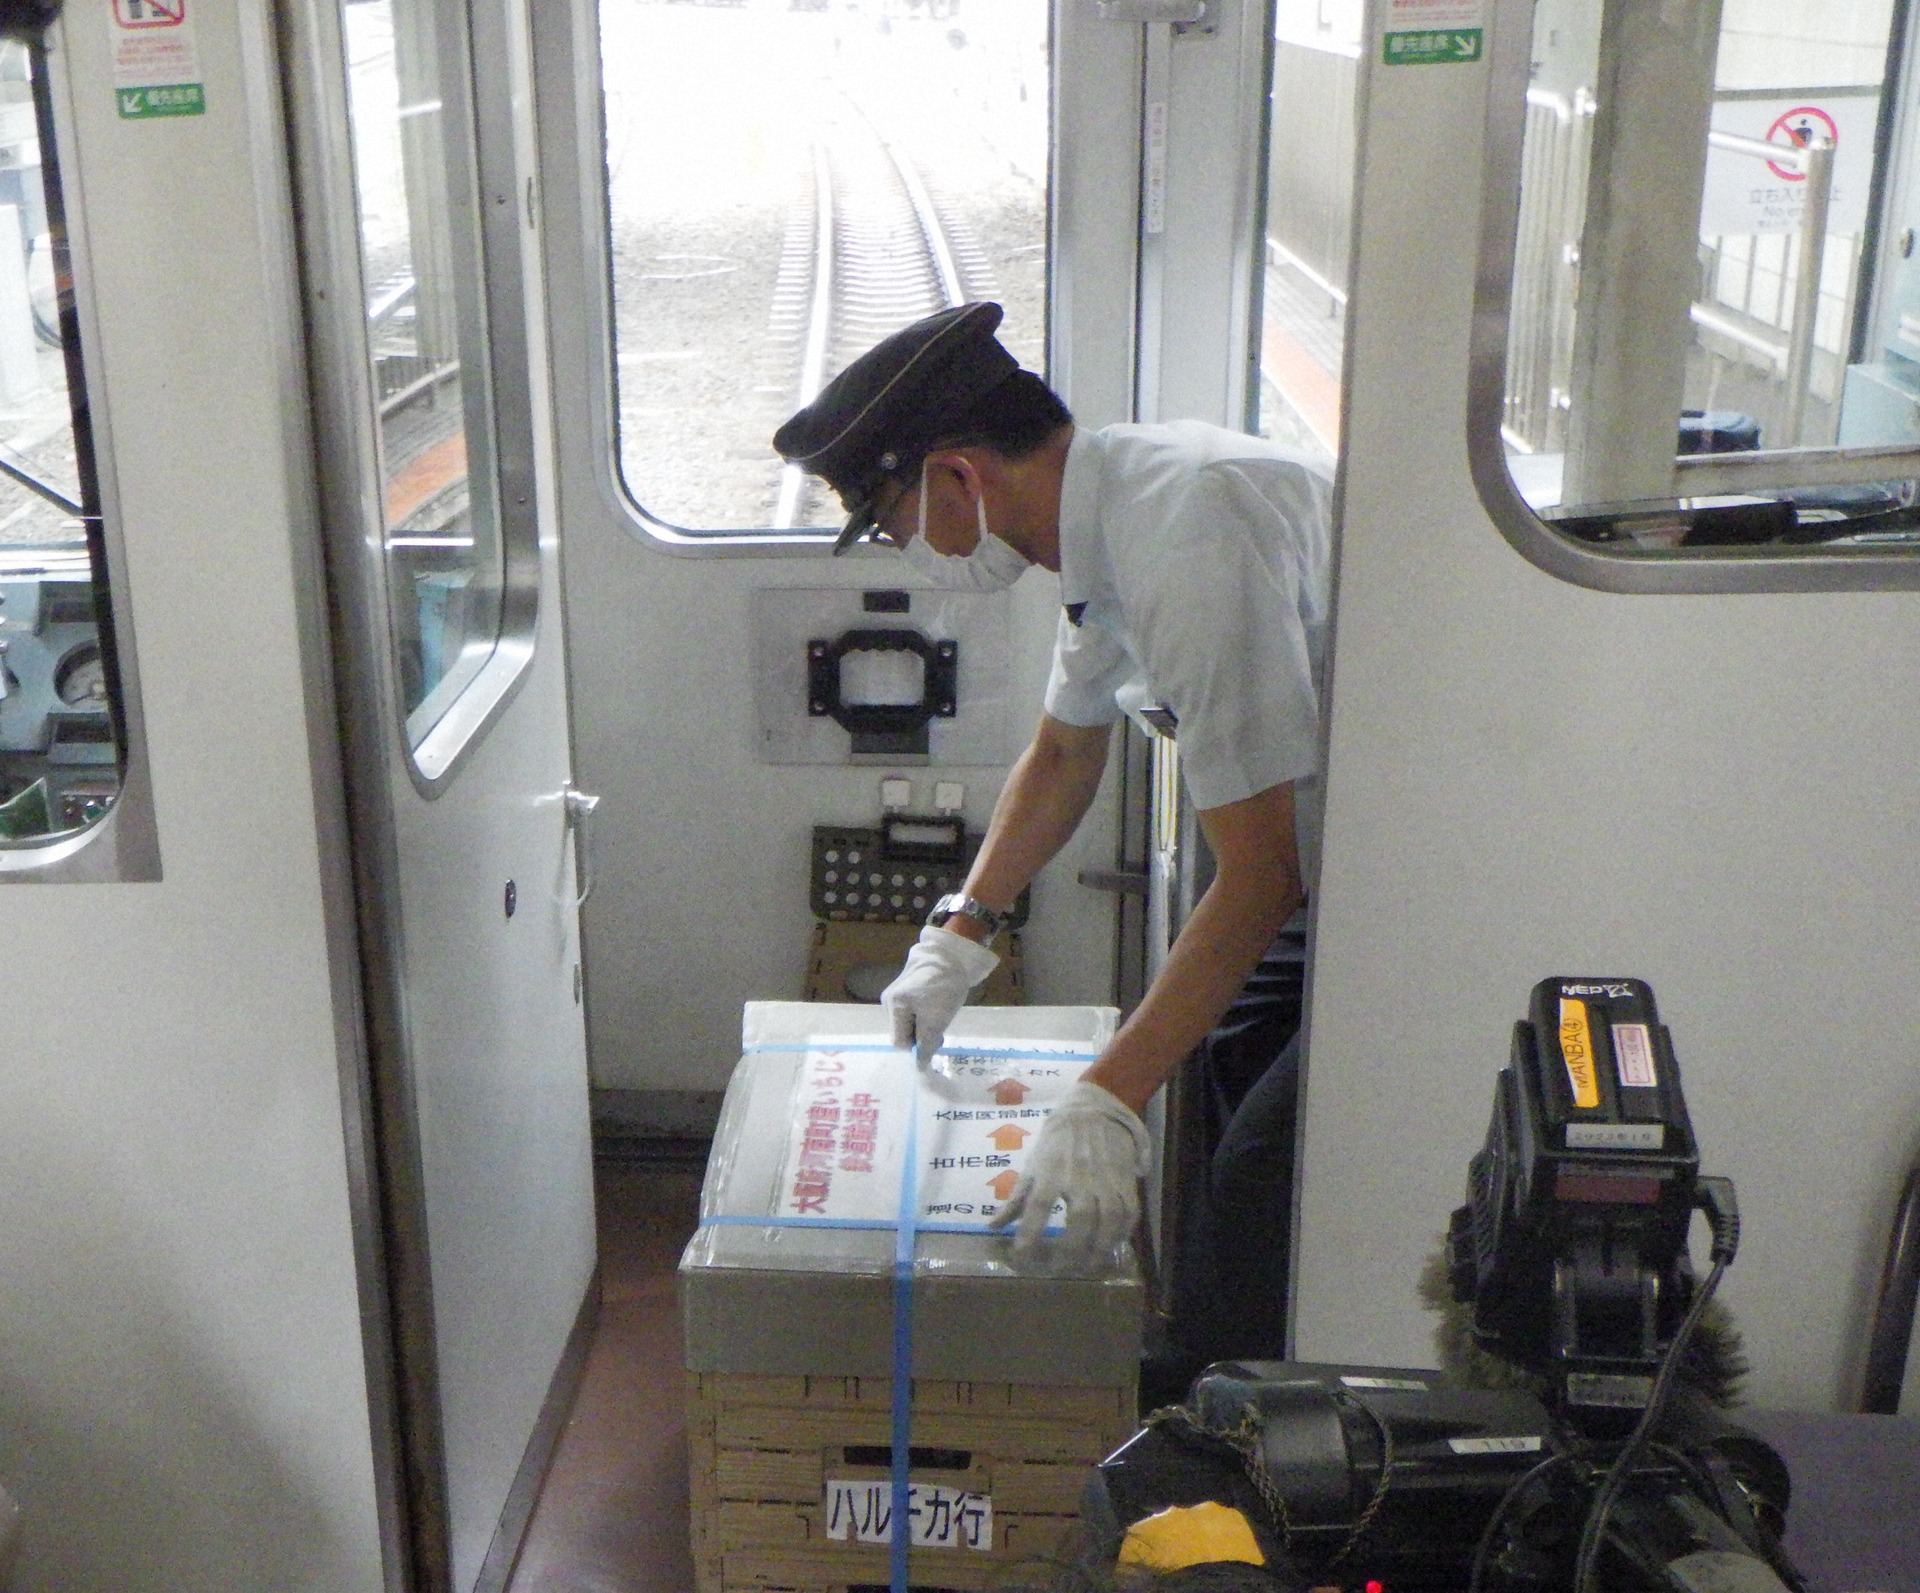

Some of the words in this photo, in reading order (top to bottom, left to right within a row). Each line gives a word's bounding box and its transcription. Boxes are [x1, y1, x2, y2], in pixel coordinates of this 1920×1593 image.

[1749, 187, 1842, 204] 立ち入り止
[929, 1153, 1011, 1169] 古市駅
